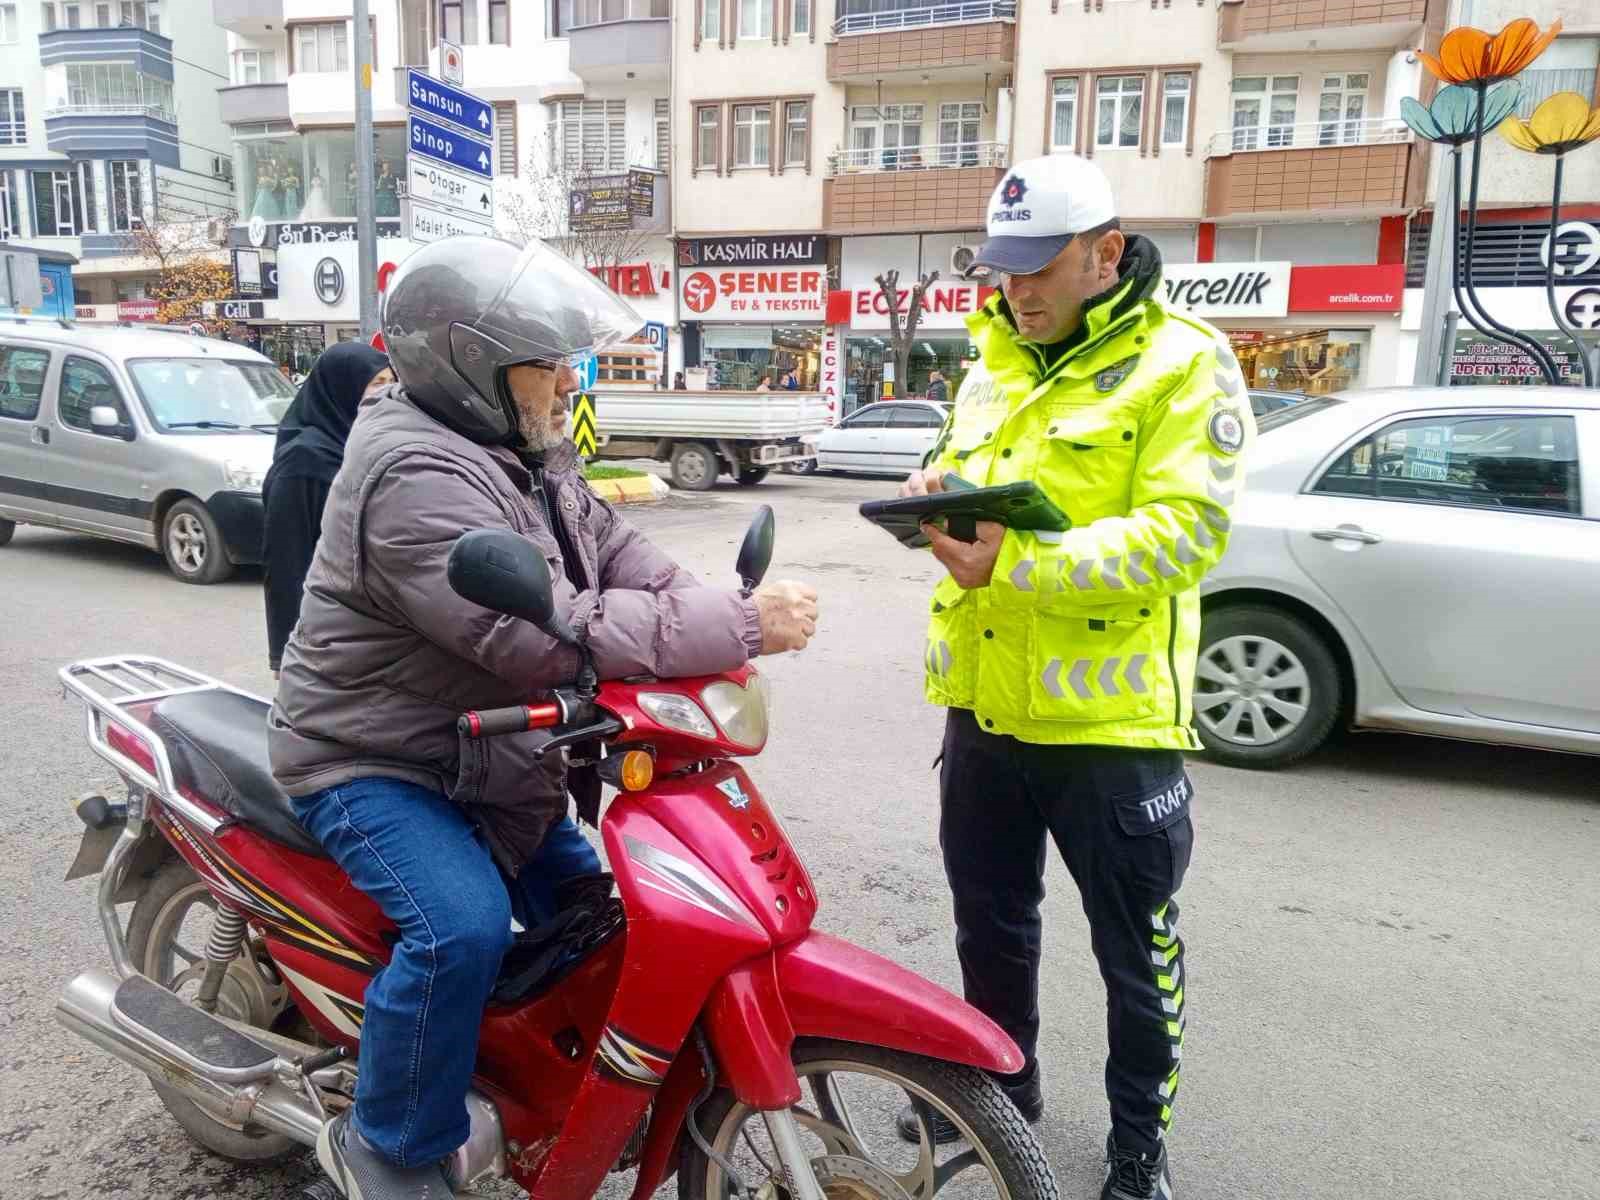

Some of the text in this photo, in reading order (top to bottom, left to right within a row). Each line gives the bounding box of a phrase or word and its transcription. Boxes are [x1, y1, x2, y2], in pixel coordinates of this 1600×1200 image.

[411, 80, 463, 117] Samsun
[412, 125, 453, 158] Sinop
[428, 170, 467, 196] Otogar
[703, 239, 768, 262] KAŞMİR
[720, 271, 819, 296] ŞENER
[731, 300, 746, 310] EV
